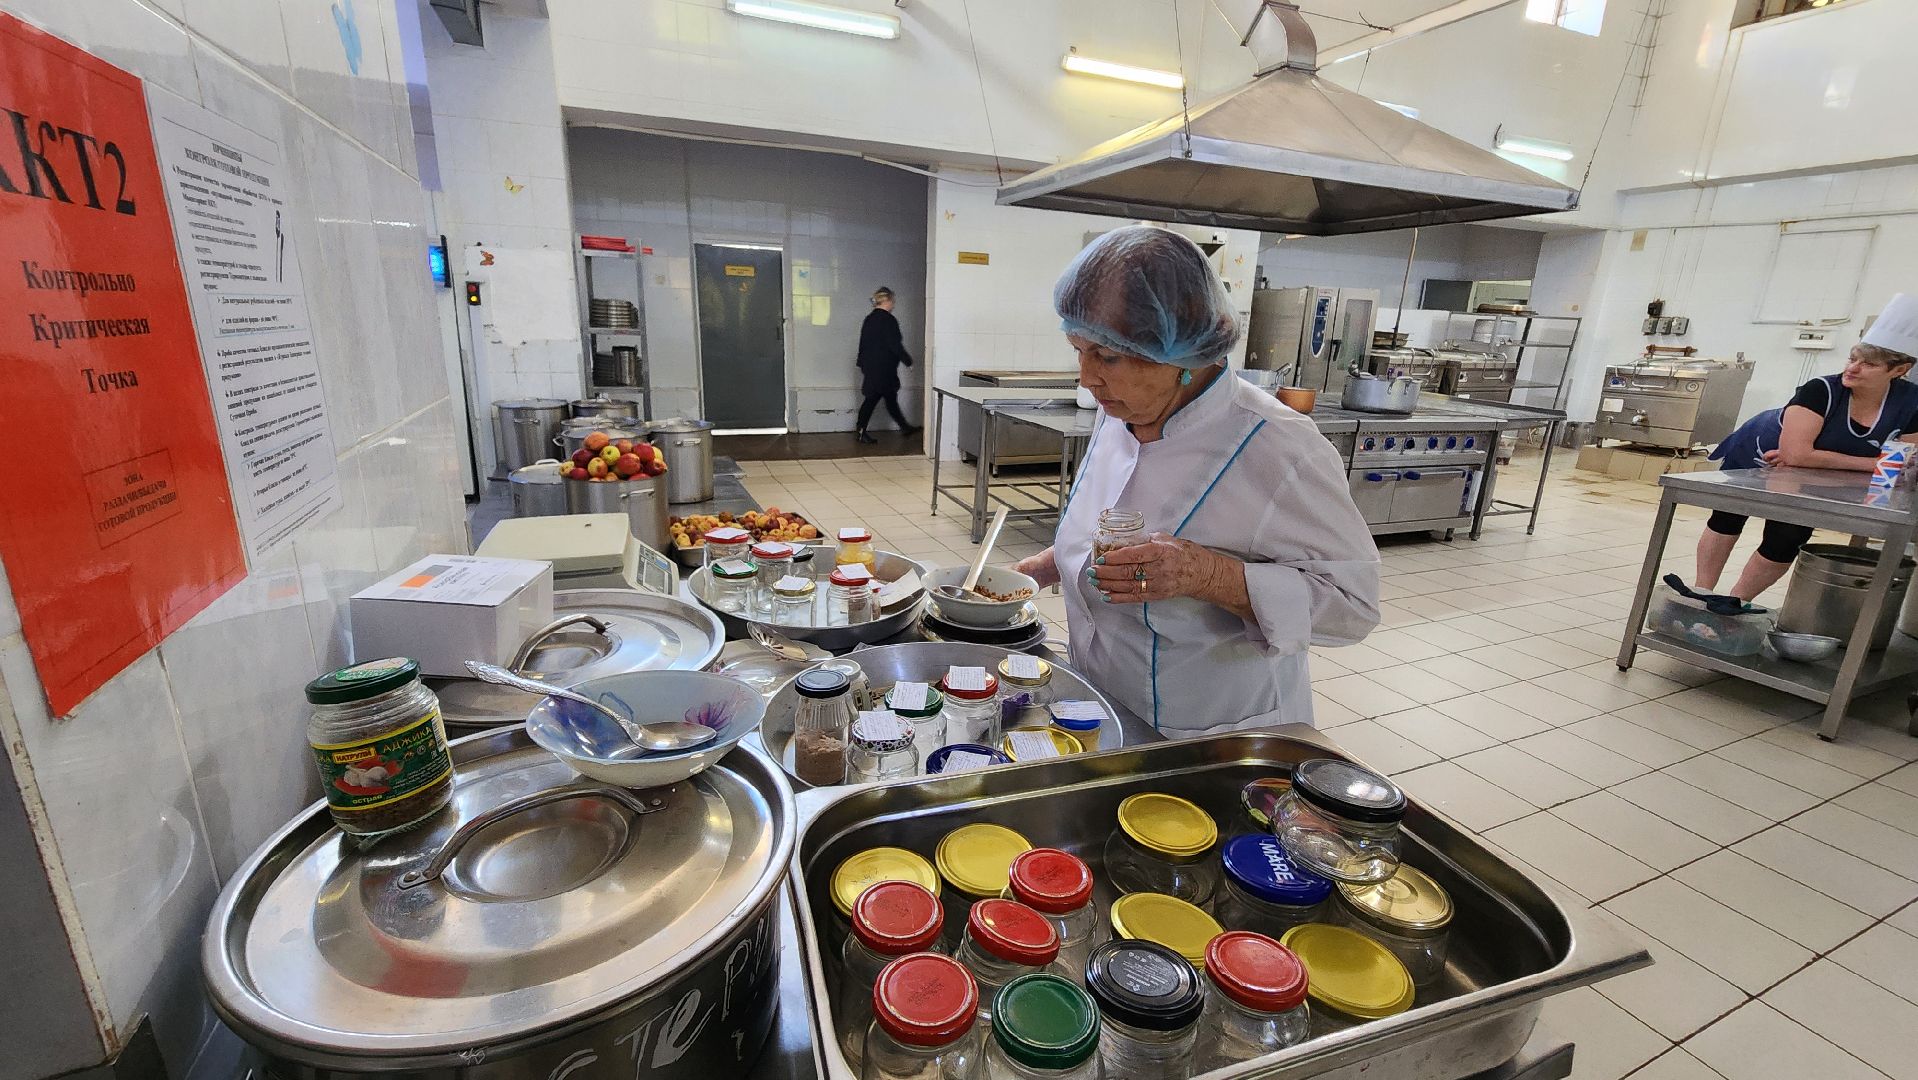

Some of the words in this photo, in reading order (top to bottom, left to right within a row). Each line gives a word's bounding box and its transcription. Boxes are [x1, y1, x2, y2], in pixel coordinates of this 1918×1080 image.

[0, 106, 137, 217] КТ2
[20, 260, 136, 298] Контрольно
[29, 313, 151, 349] Критическая
[81, 368, 139, 394] Точка
[1259, 842, 1296, 884] MARE
